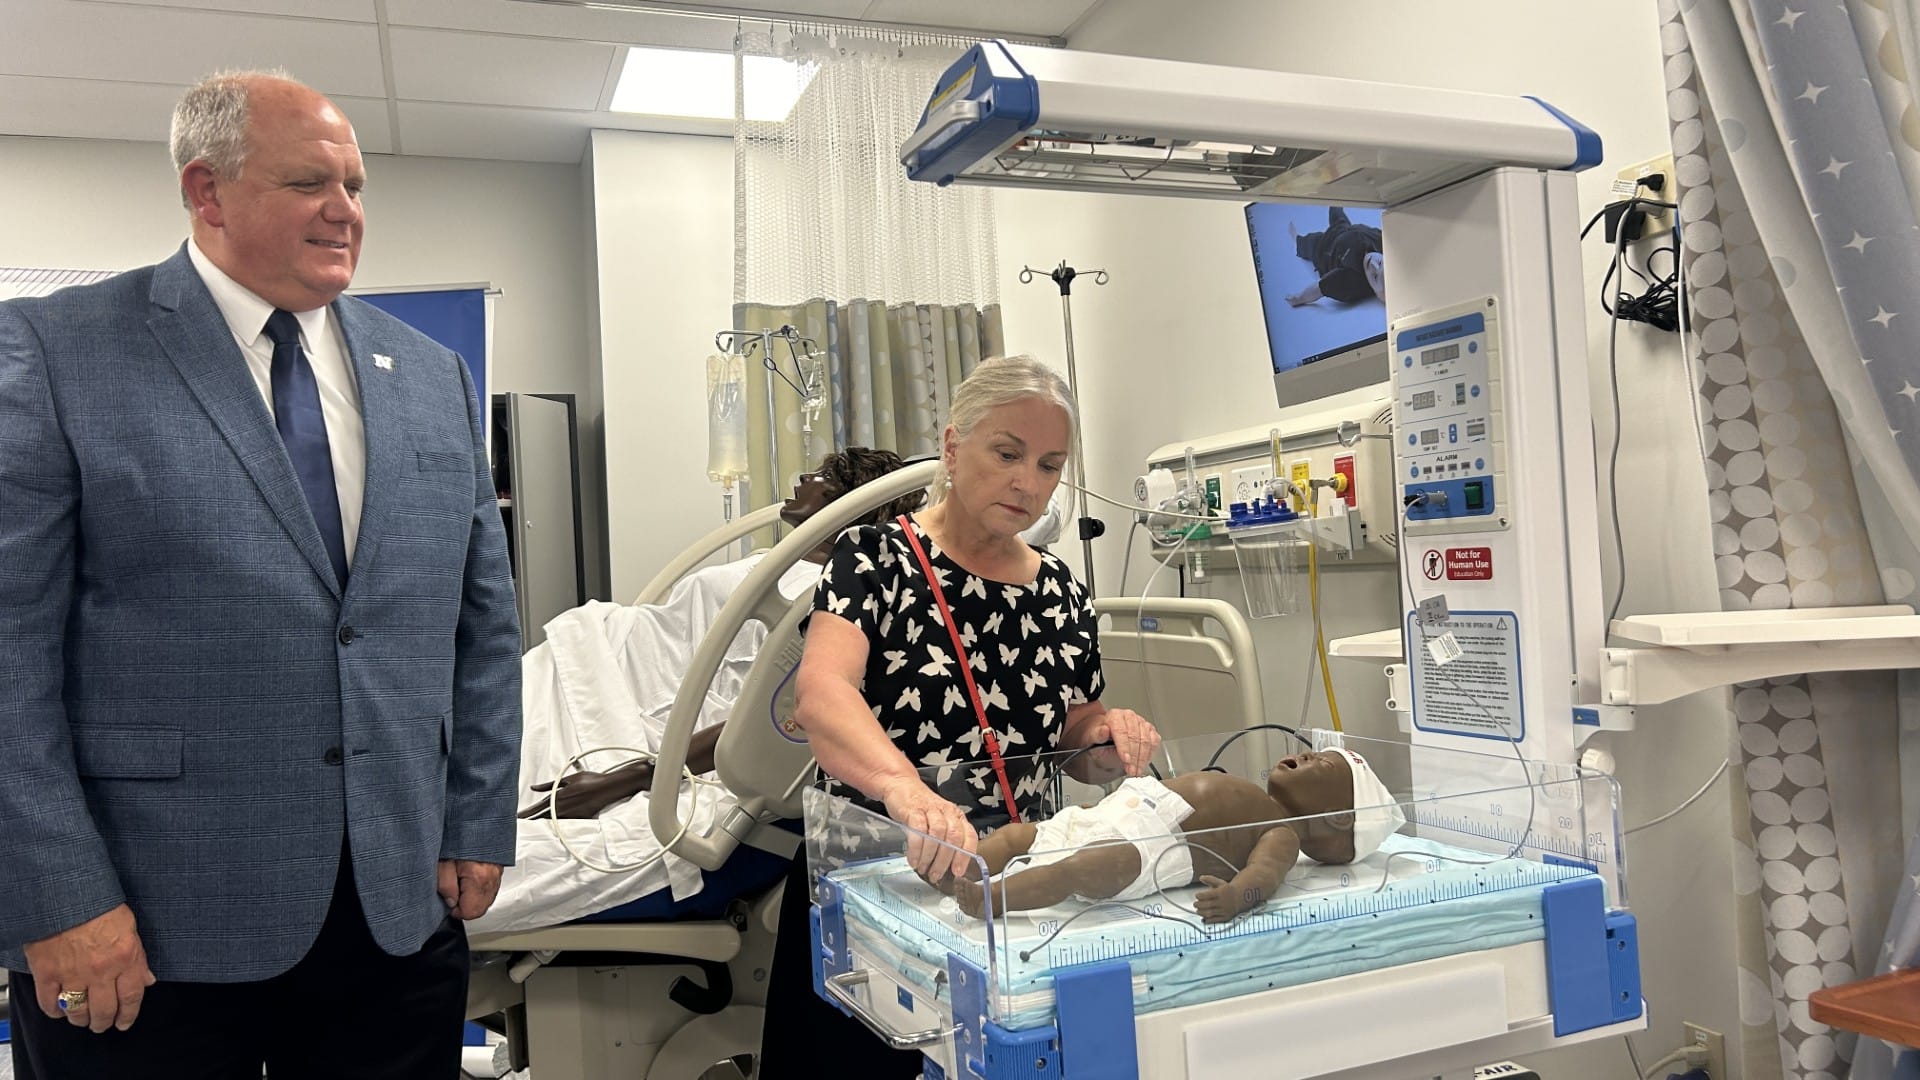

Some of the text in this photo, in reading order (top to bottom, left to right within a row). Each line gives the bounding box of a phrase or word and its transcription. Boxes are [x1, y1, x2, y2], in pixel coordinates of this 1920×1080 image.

[370, 353, 393, 371] N
[1436, 454, 1458, 462] ALARM
[1455, 550, 1481, 559] Not for
[1448, 560, 1489, 569] Human Use
[1558, 816, 1573, 829] 20
